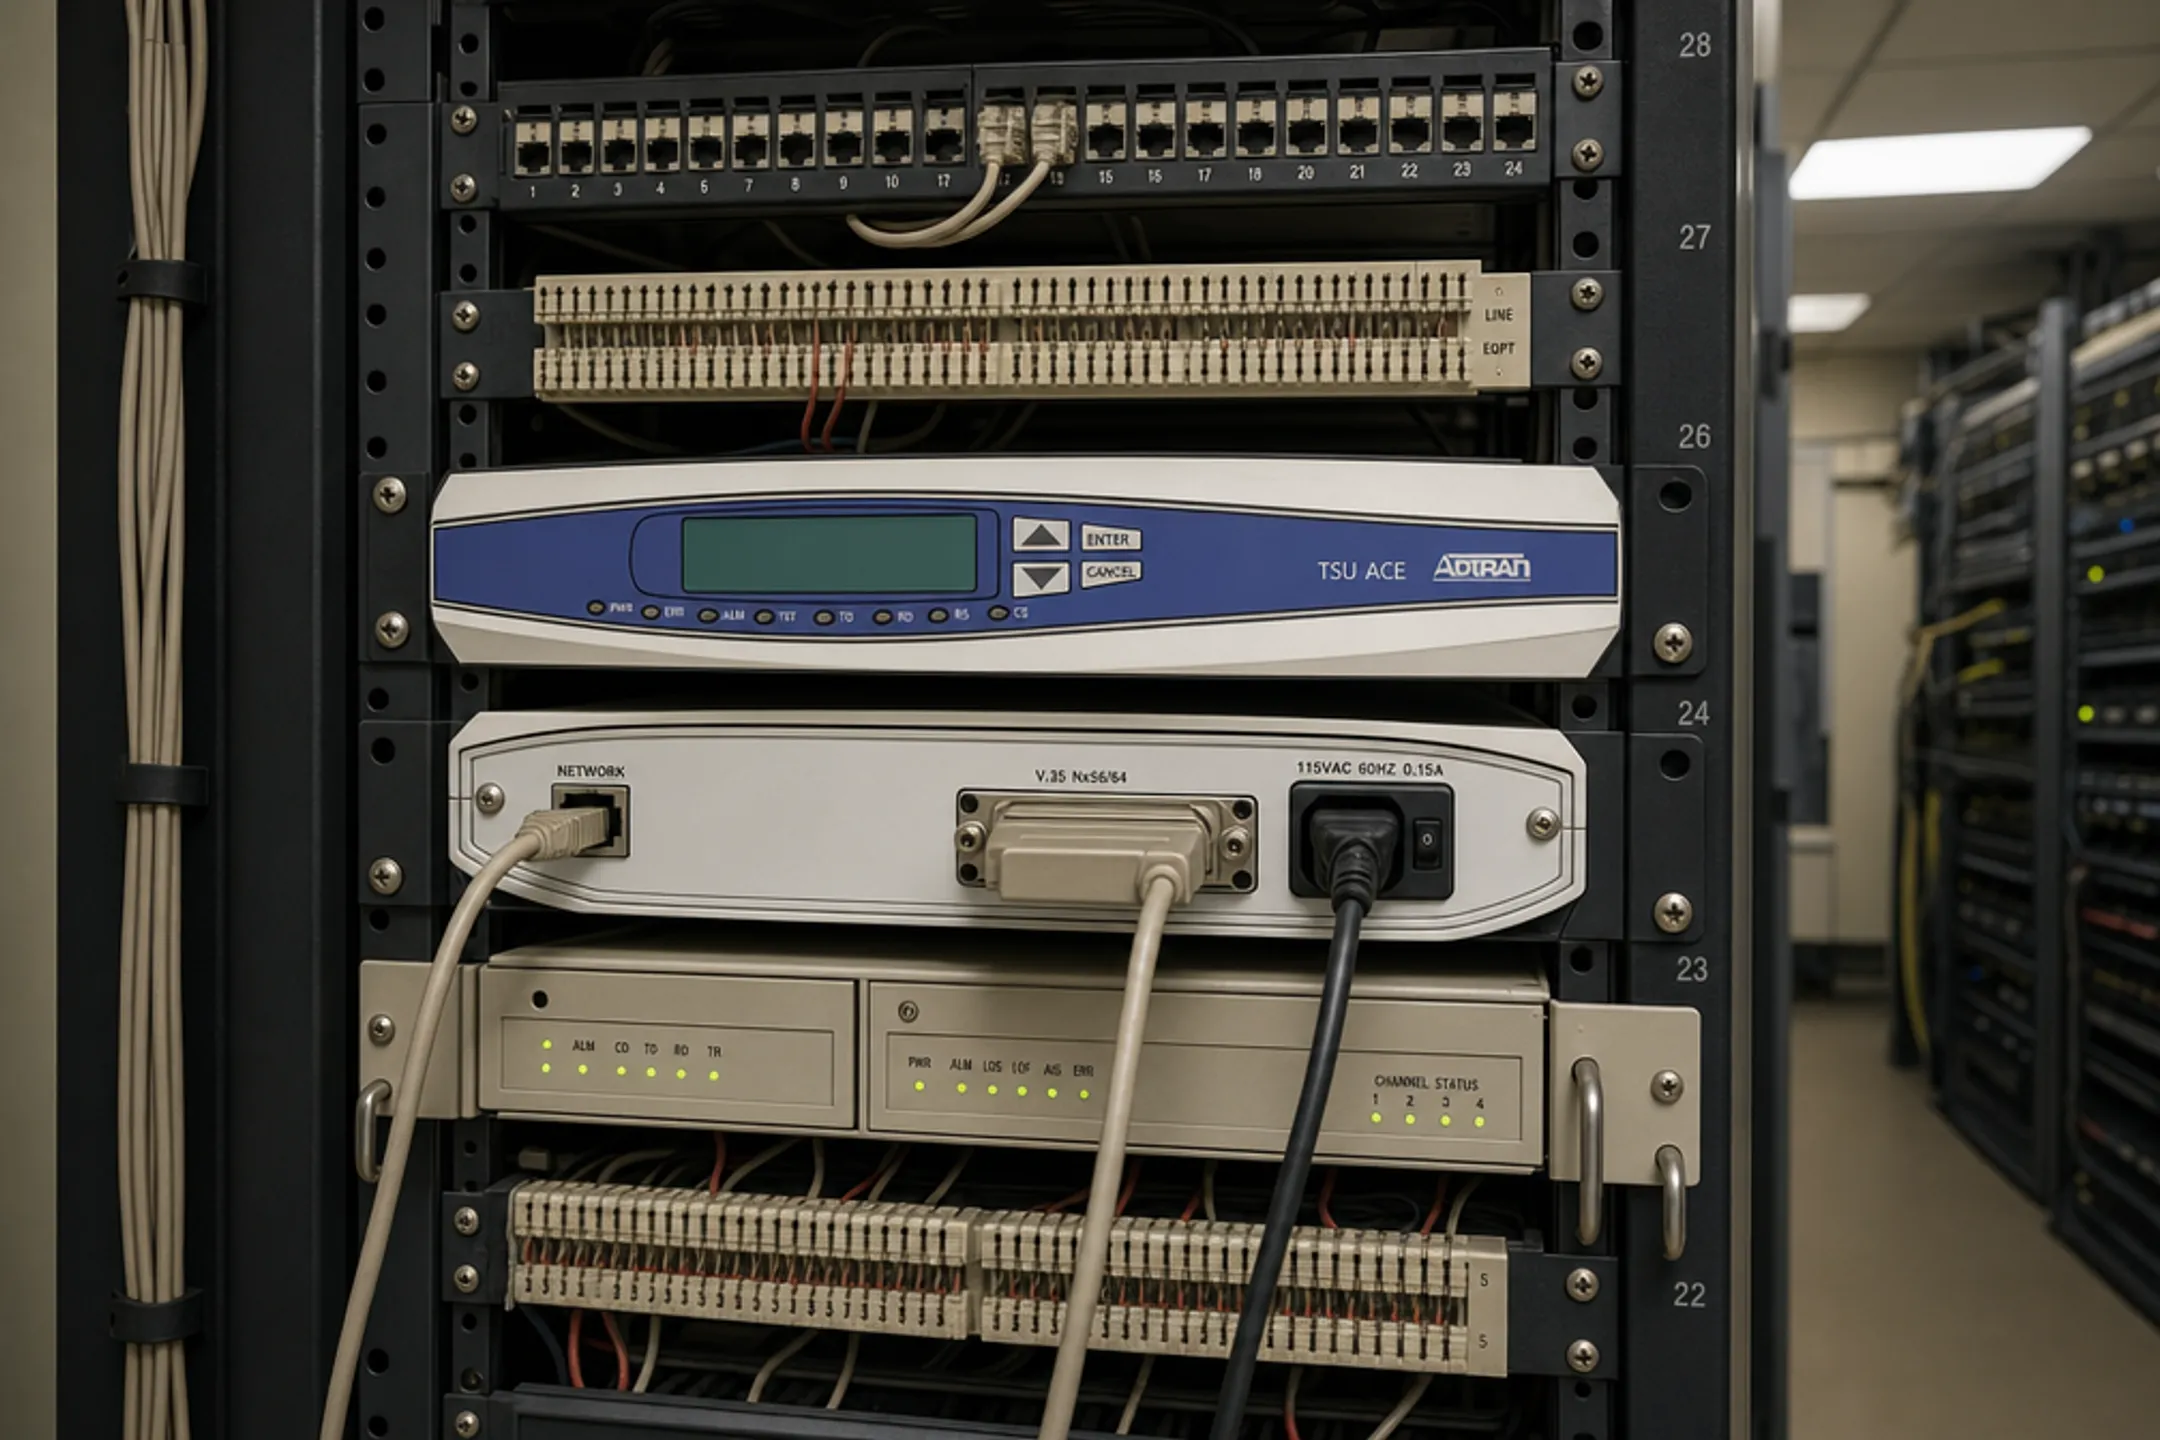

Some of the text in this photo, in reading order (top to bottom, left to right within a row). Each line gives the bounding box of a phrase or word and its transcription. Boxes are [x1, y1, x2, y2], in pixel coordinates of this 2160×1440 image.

[1680, 32, 1711, 57] 28
[530, 185, 536, 198] 1
[571, 184, 580, 198] 2
[613, 182, 622, 196] 3
[656, 181, 665, 195] 4
[744, 178, 754, 192] 7
[791, 177, 800, 191] 8
[839, 176, 848, 190] 9
[886, 174, 899, 189] 10
[1198, 167, 1212, 182] 17
[1249, 167, 1262, 181] 18
[1297, 165, 1315, 180] 20
[1350, 164, 1365, 180] 21
[1401, 163, 1418, 179] 22
[1453, 161, 1472, 177] 23
[1505, 160, 1522, 176] 24
[1680, 223, 1711, 250] 27
[1485, 308, 1513, 322] LINE
[1680, 423, 1711, 449] 26
[1087, 533, 1129, 546] ENTER
[1318, 561, 1406, 580] TSU ACE
[1432, 553, 1532, 582] ADTRAN
[1678, 700, 1710, 726] 24
[557, 765, 625, 777] NETWORK
[1298, 761, 1444, 776] 115VAC 60HZ 0.15A
[1677, 955, 1708, 981] 23
[572, 1040, 595, 1052] ALM
[908, 1057, 931, 1068] PWR
[950, 1059, 972, 1071] ALM
[1436, 1077, 1479, 1091] STATUS
[1407, 1095, 1414, 1106] 2
[1442, 1096, 1450, 1107] 3
[1476, 1098, 1484, 1109] 4
[1674, 1281, 1706, 1308] 22
